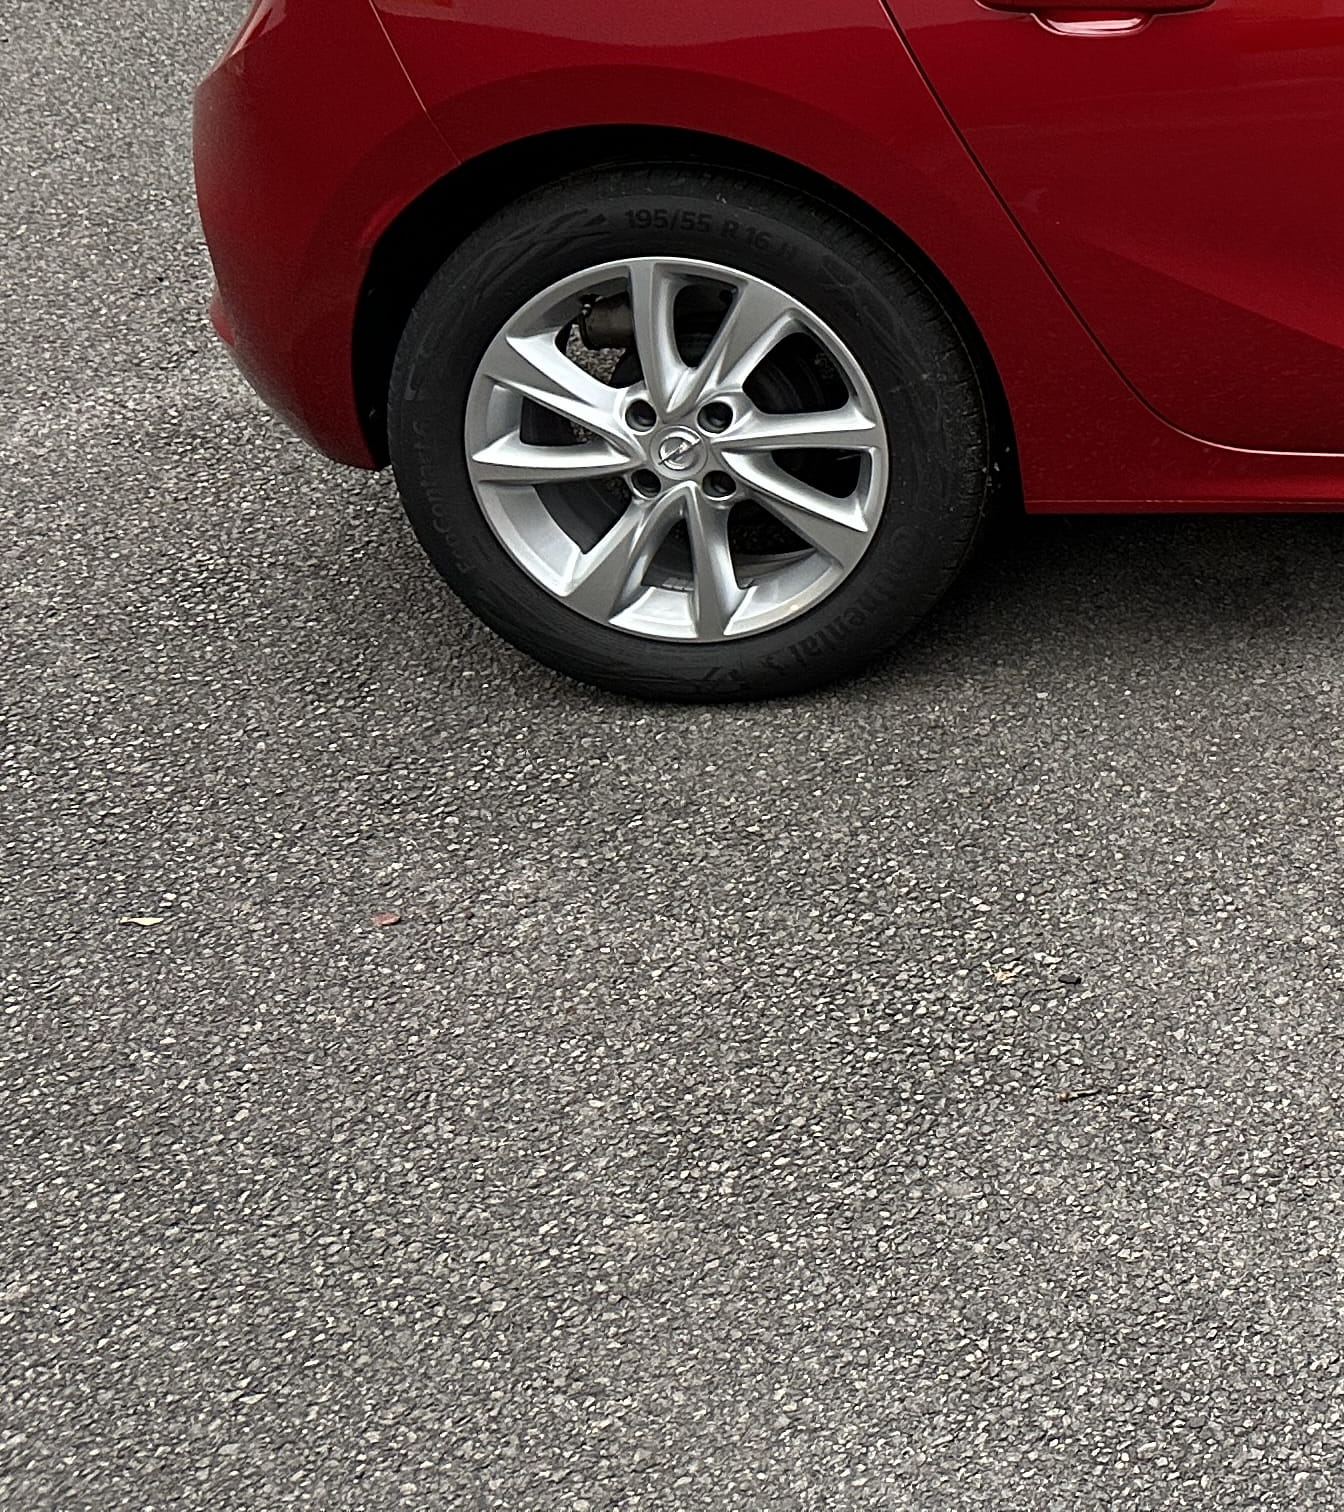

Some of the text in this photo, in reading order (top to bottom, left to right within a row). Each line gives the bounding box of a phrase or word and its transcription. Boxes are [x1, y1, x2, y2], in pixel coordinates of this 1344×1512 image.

[625, 208, 712, 233] 195/55
[721, 219, 740, 240] R
[746, 226, 772, 251] 16
